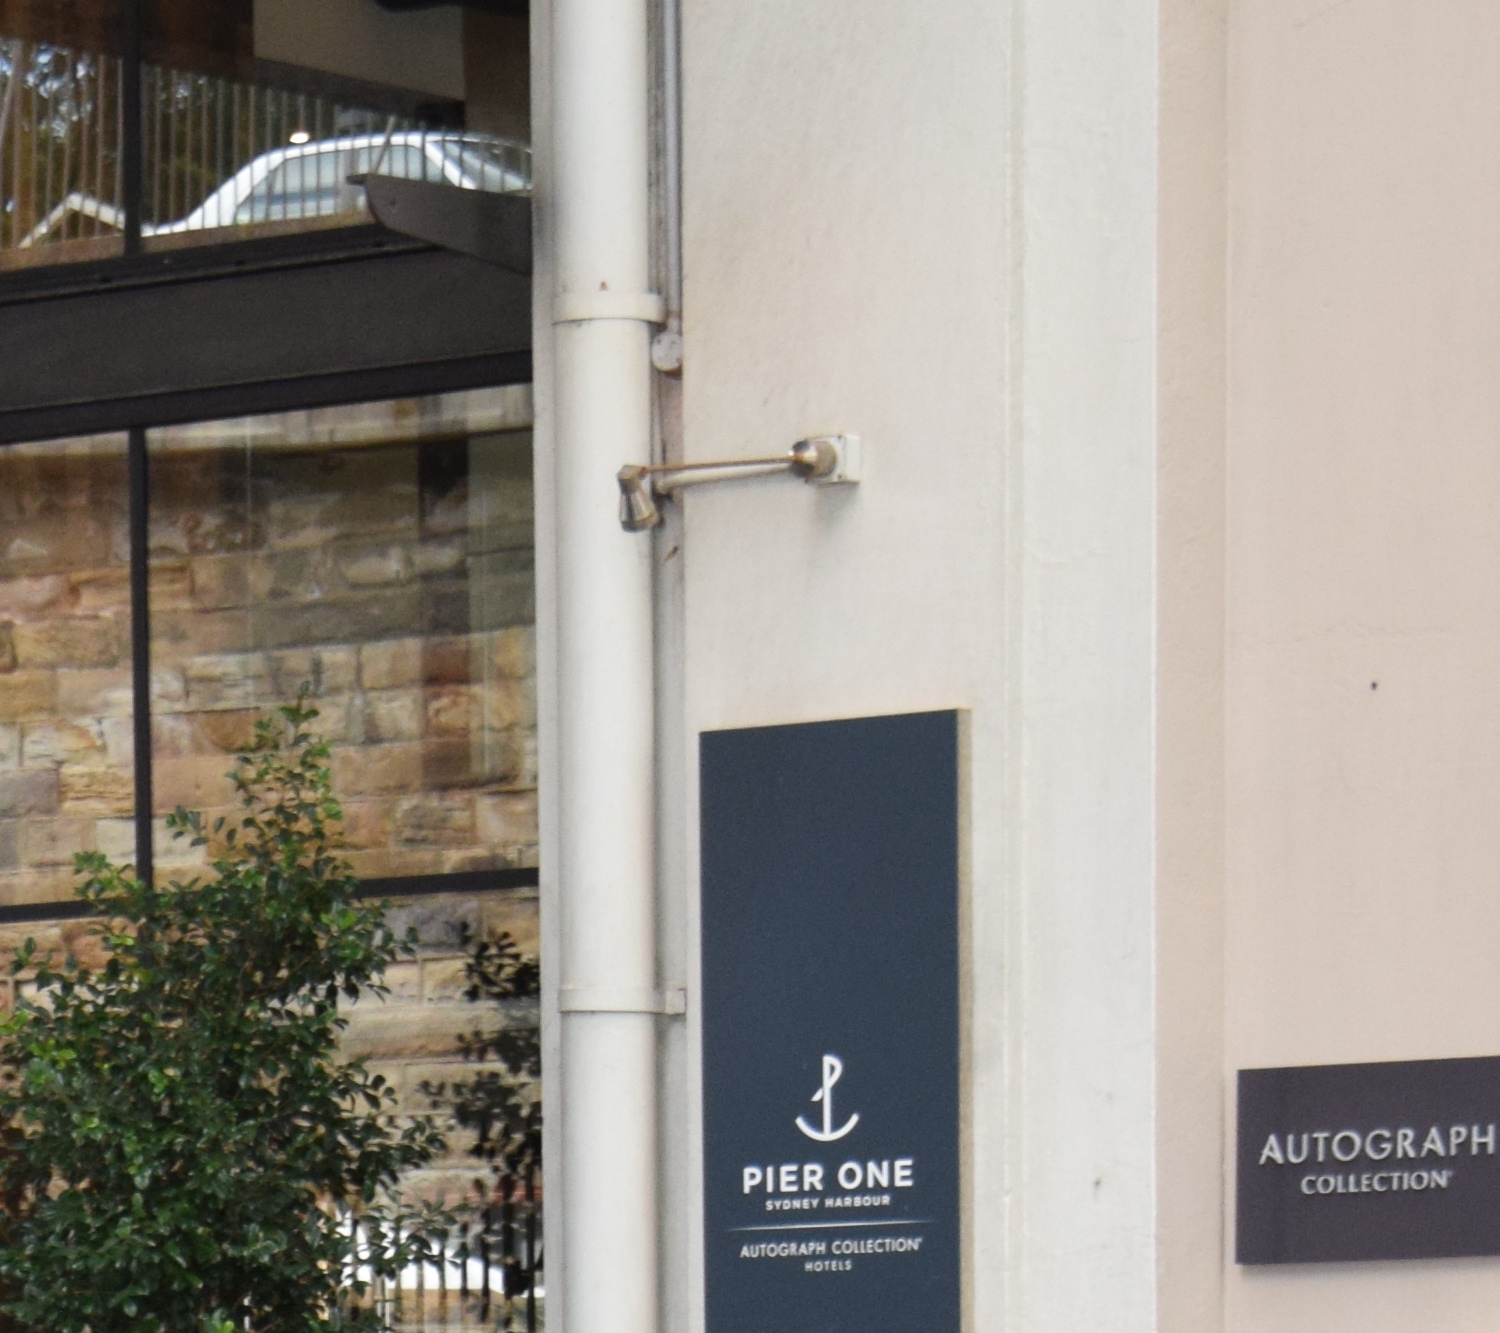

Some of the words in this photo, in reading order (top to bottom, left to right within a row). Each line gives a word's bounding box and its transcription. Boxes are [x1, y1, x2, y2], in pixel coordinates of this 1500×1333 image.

[1259, 1123, 1498, 1166] AUTOGRAPH
[742, 1164, 824, 1194] PIER
[838, 1159, 914, 1190] ONE
[1301, 1170, 1453, 1194] COLLECTION
[765, 1198, 820, 1211] SYDNEY
[824, 1195, 891, 1208] HARBOUR
[740, 1241, 826, 1259] AUTOGRAPH
[804, 1260, 852, 1272] HOTELS
